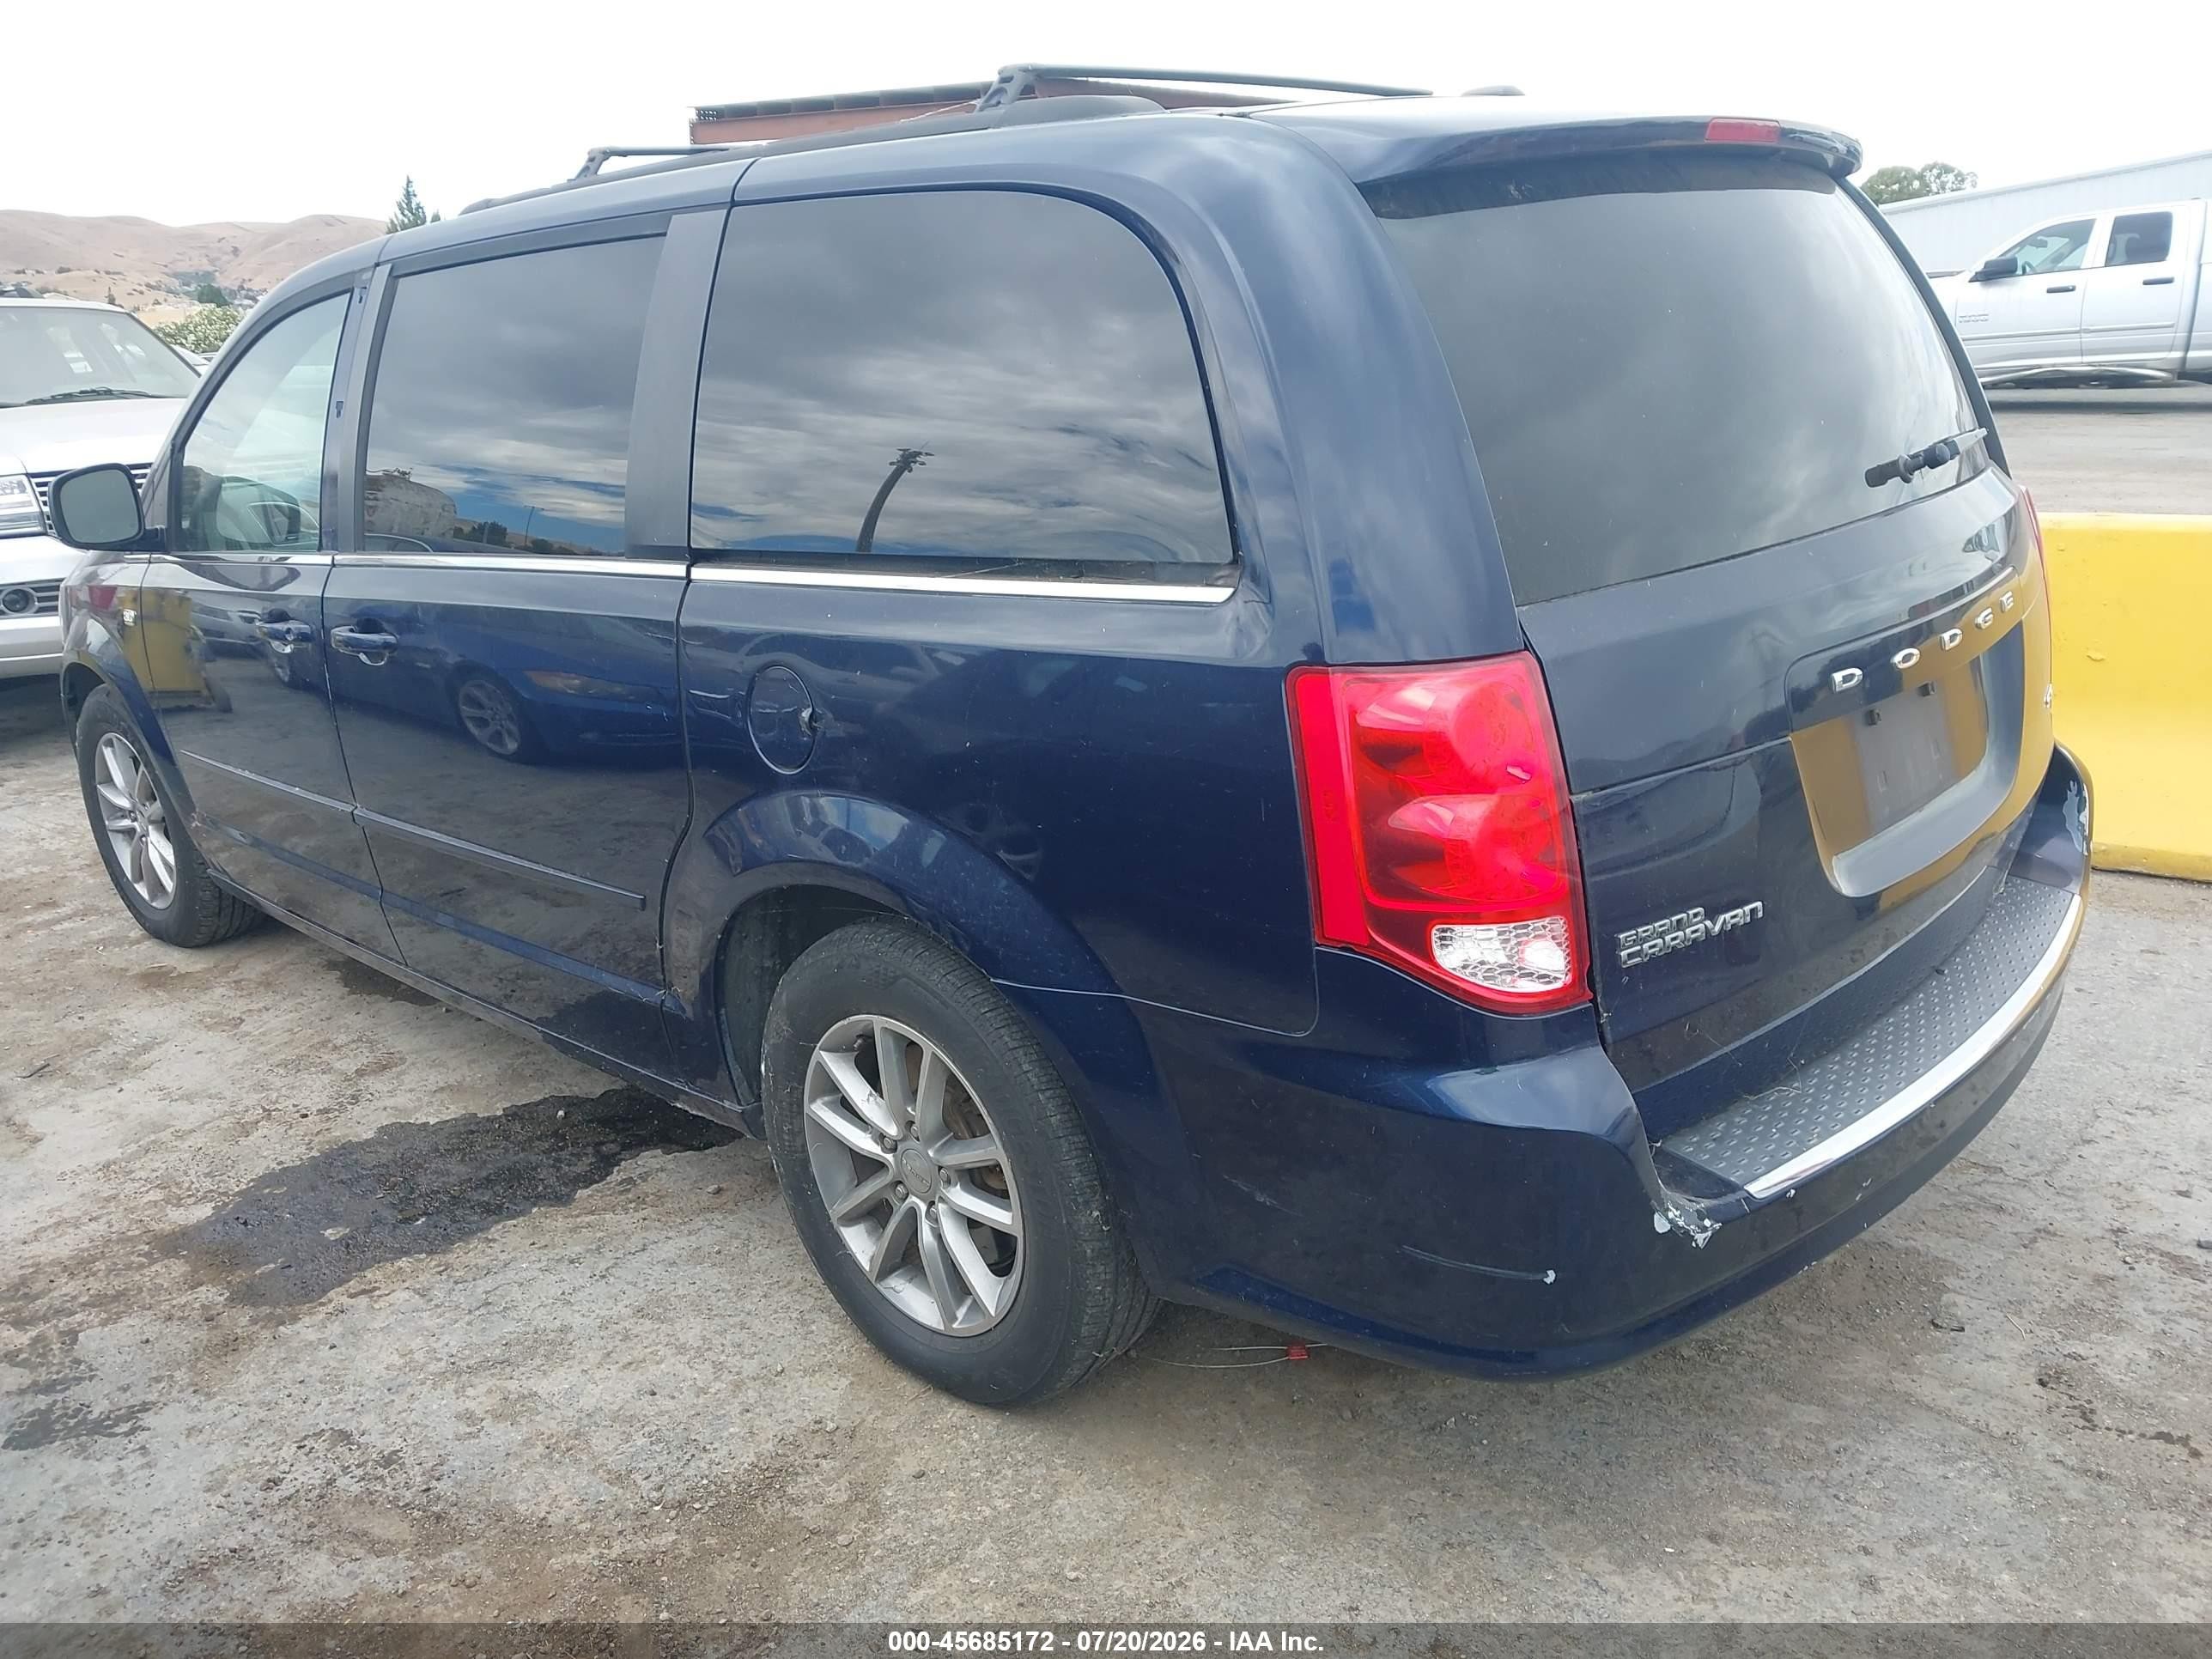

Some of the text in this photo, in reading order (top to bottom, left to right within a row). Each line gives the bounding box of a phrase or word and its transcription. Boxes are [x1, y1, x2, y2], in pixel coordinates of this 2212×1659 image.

[1832, 591, 2014, 693] DODGE
[1618, 907, 1705, 949] GRAND
[1620, 901, 1764, 969] CARAVAN
